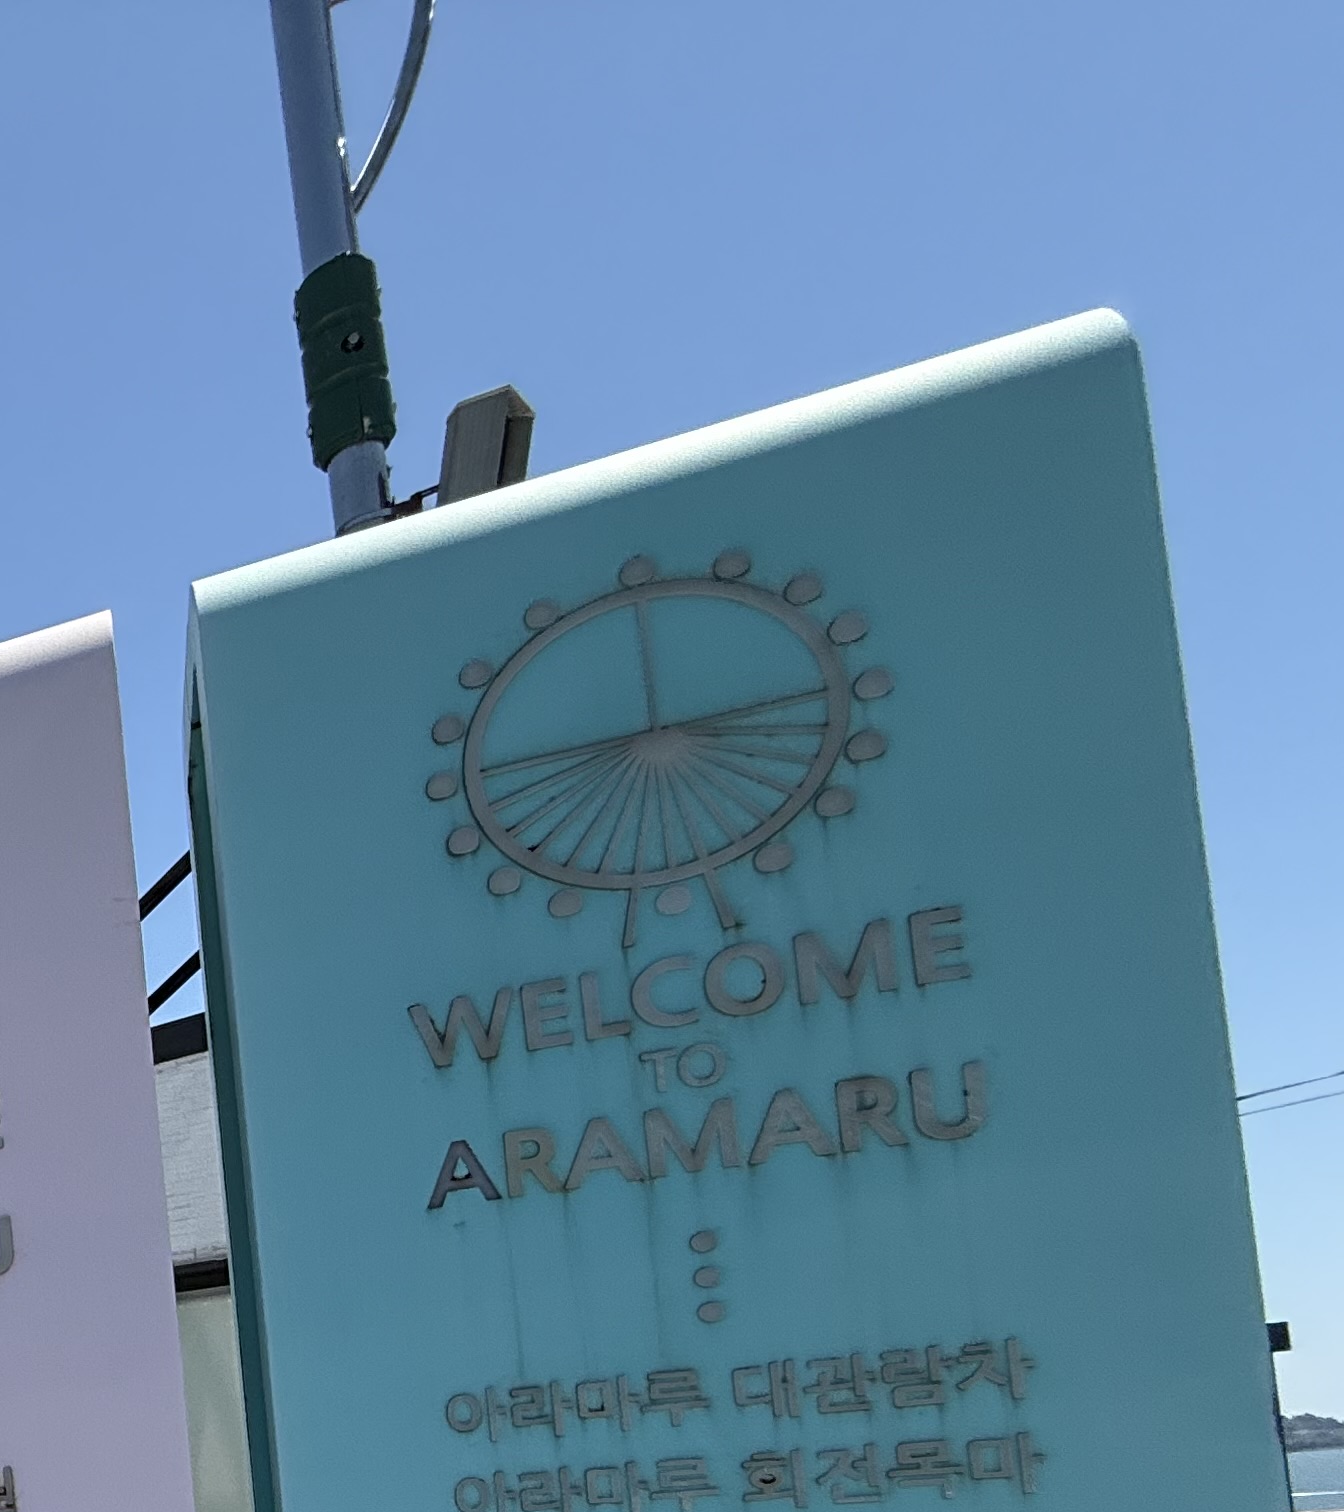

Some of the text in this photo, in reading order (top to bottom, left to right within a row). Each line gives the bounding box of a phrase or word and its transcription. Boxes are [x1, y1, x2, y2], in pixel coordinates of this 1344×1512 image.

[408, 905, 972, 1068] WELCOME
[639, 1042, 726, 1092] TO
[426, 1060, 988, 1210] ARAMARU
[445, 1337, 1033, 1441] 아라마루 대관람차
[742, 1432, 1045, 1507] 회전목마
